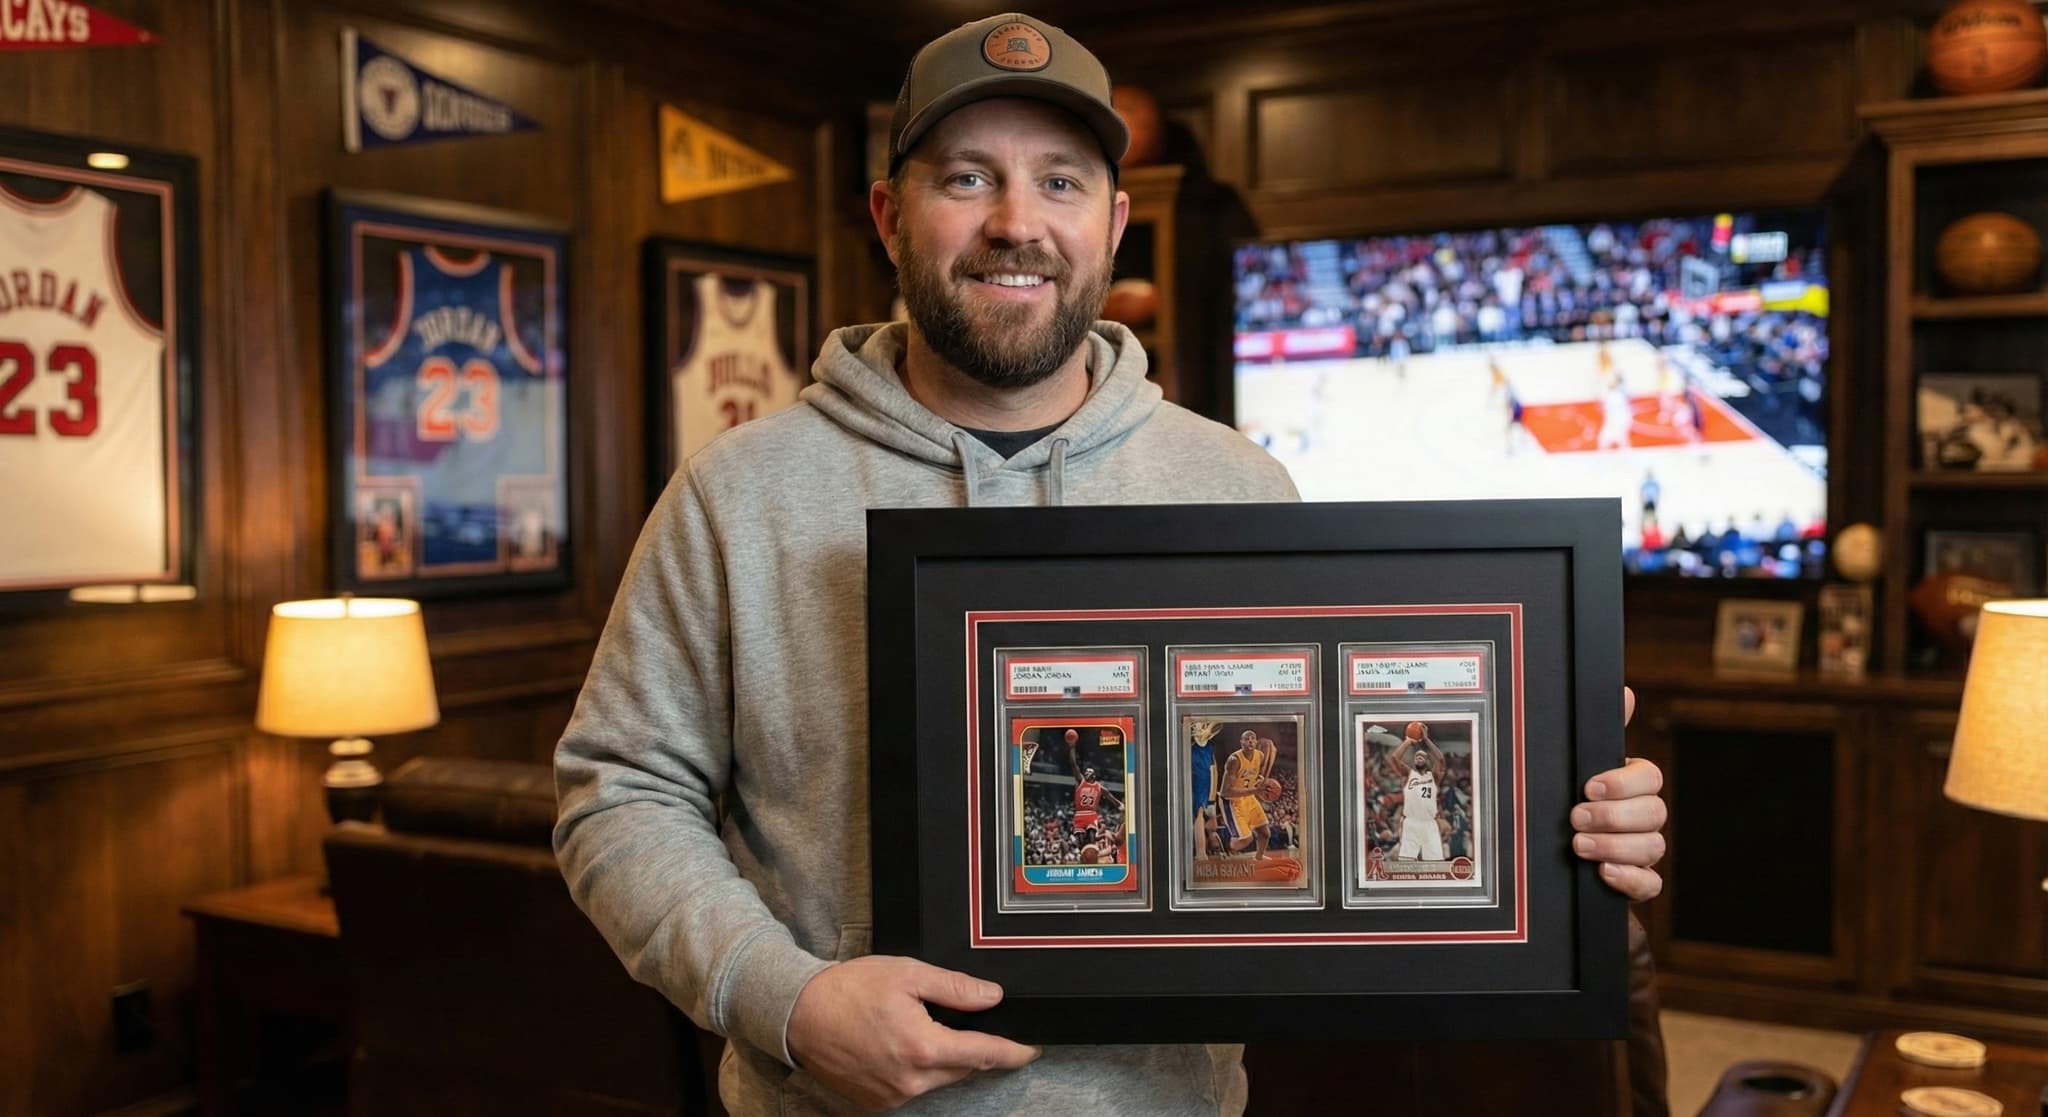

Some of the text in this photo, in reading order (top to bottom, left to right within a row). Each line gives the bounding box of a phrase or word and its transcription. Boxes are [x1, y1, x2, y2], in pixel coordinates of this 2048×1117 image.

[0, 0, 90, 42] CAYS
[0, 268, 106, 329] ORDAN
[0, 341, 98, 437] 23
[416, 356, 501, 442] 23
